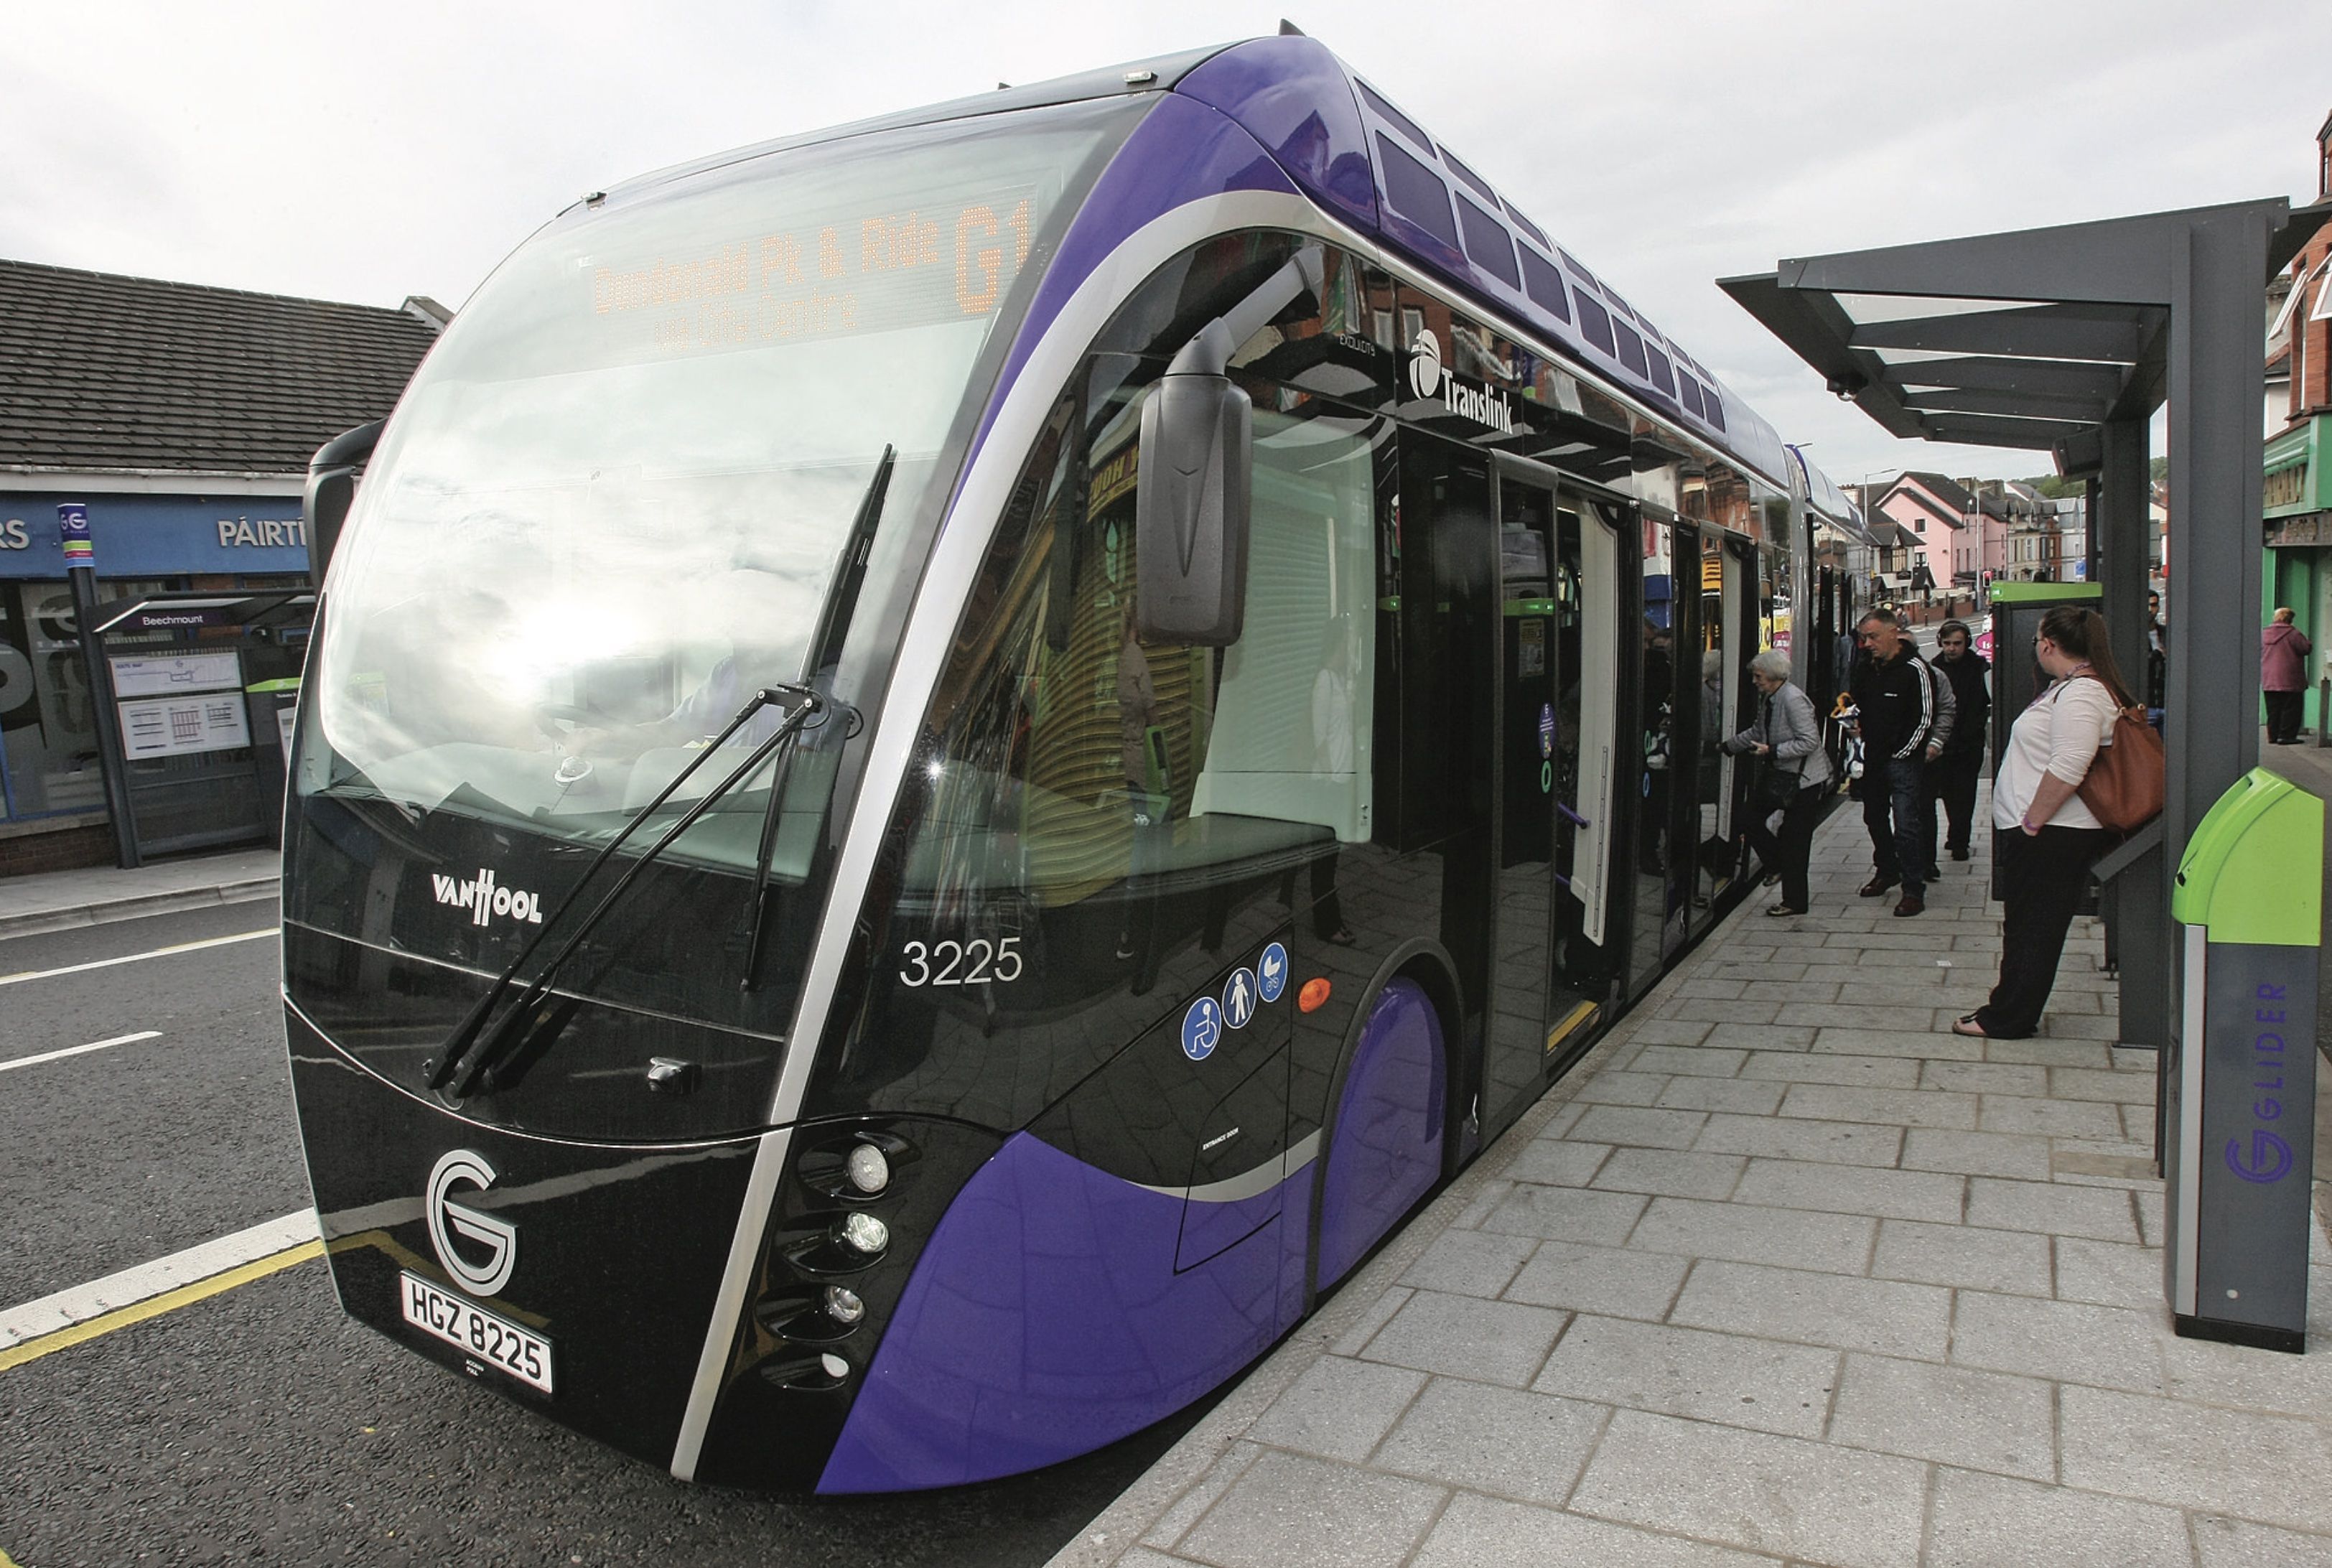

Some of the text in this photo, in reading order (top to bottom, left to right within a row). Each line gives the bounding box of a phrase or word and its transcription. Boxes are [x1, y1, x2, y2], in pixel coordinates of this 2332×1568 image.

[596, 211, 939, 314] Dundonald Pk & Ride
[956, 199, 1030, 314] G1
[758, 286, 857, 338] Centre
[1442, 367, 1513, 435] Translink
[218, 516, 307, 546] PÁIRTÍ
[143, 615, 204, 625] Beechmount
[900, 937, 1023, 987] 3225
[2253, 982, 2287, 1121] GLIDER
[411, 1283, 542, 1381] HGZ 8225
